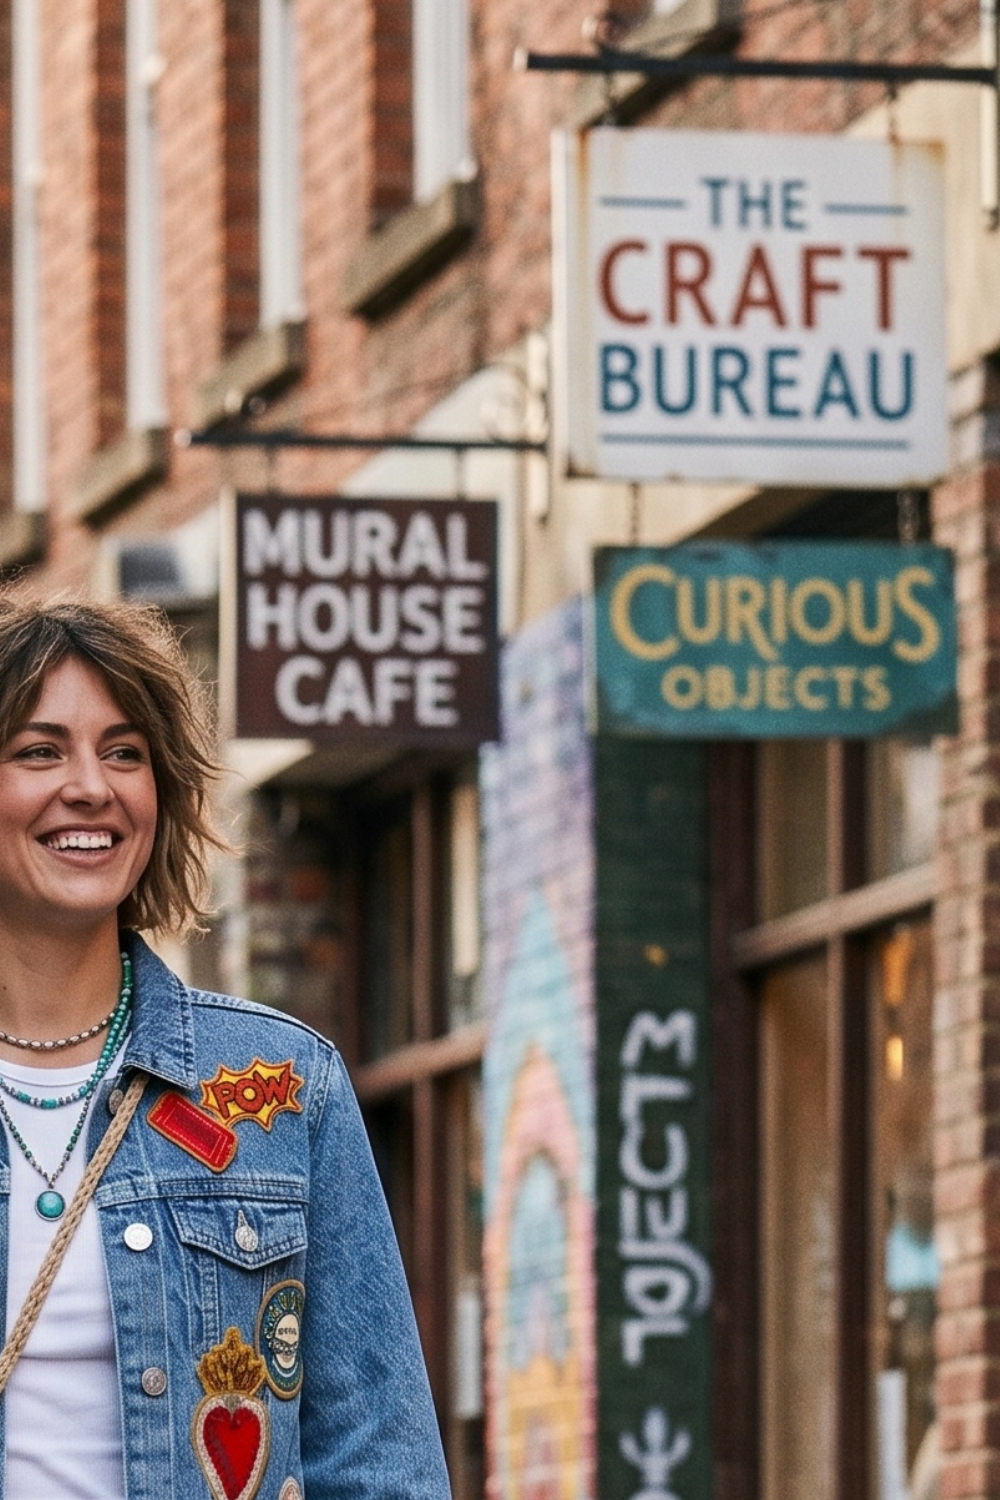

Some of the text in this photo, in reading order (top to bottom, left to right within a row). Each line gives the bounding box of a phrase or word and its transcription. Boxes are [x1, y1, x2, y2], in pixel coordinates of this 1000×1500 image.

[701, 177, 806, 230] THE
[598, 240, 911, 331] CRAFT
[600, 343, 914, 420] BUREAU
[243, 508, 489, 580] MURAL
[246, 583, 486, 653] HOUSE
[609, 564, 941, 662] CURIOUS
[274, 655, 460, 727] CAFE
[661, 665, 893, 712] OBJECTS
[211, 1066, 291, 1119] POW
